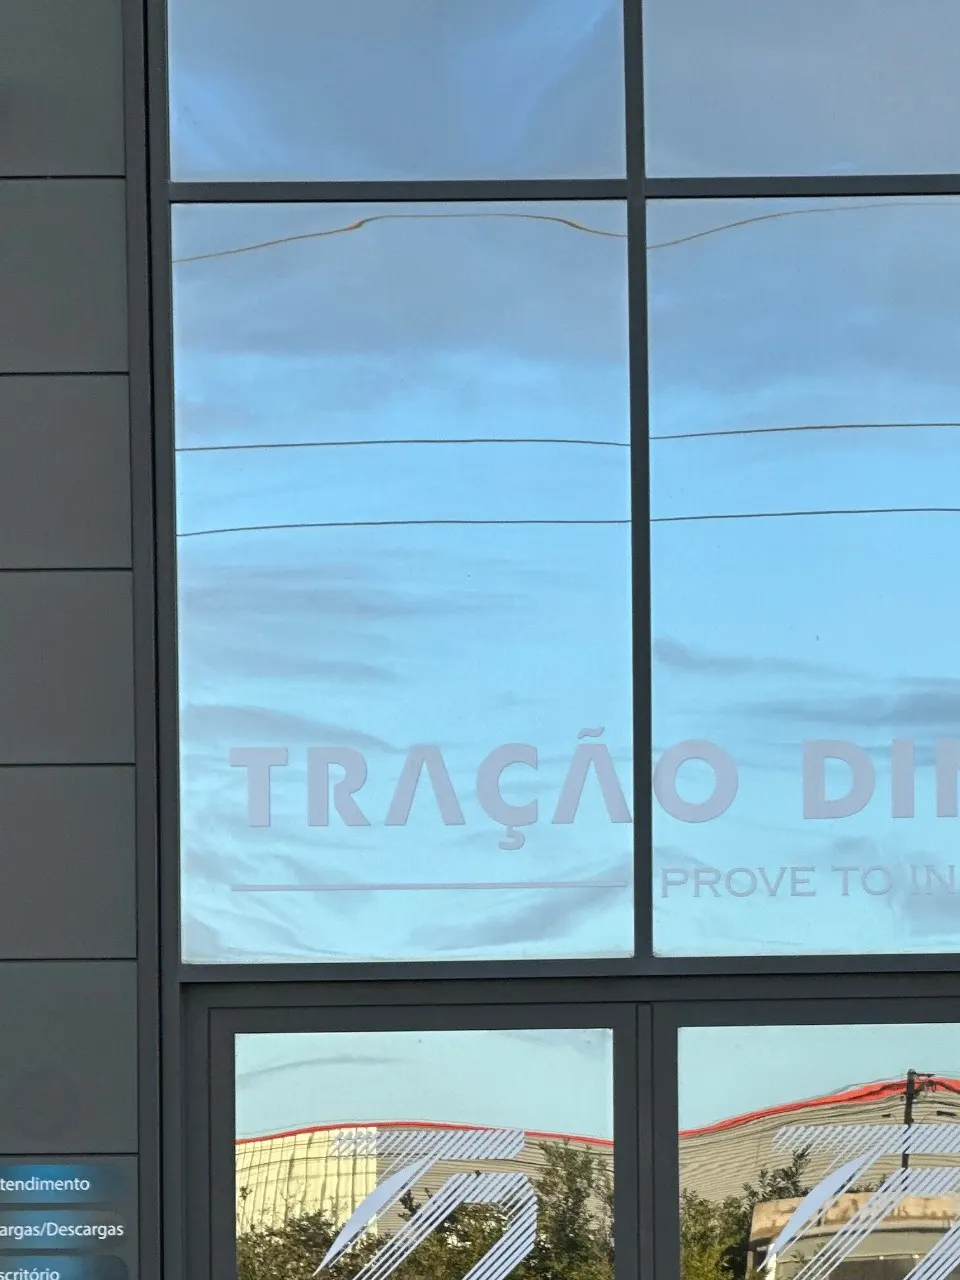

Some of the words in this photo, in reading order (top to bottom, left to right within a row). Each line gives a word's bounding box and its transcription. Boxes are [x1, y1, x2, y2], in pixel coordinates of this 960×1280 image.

[229, 727, 738, 850] TRAÇÃO
[660, 866, 816, 898] PROVE
[831, 865, 893, 896] TO
